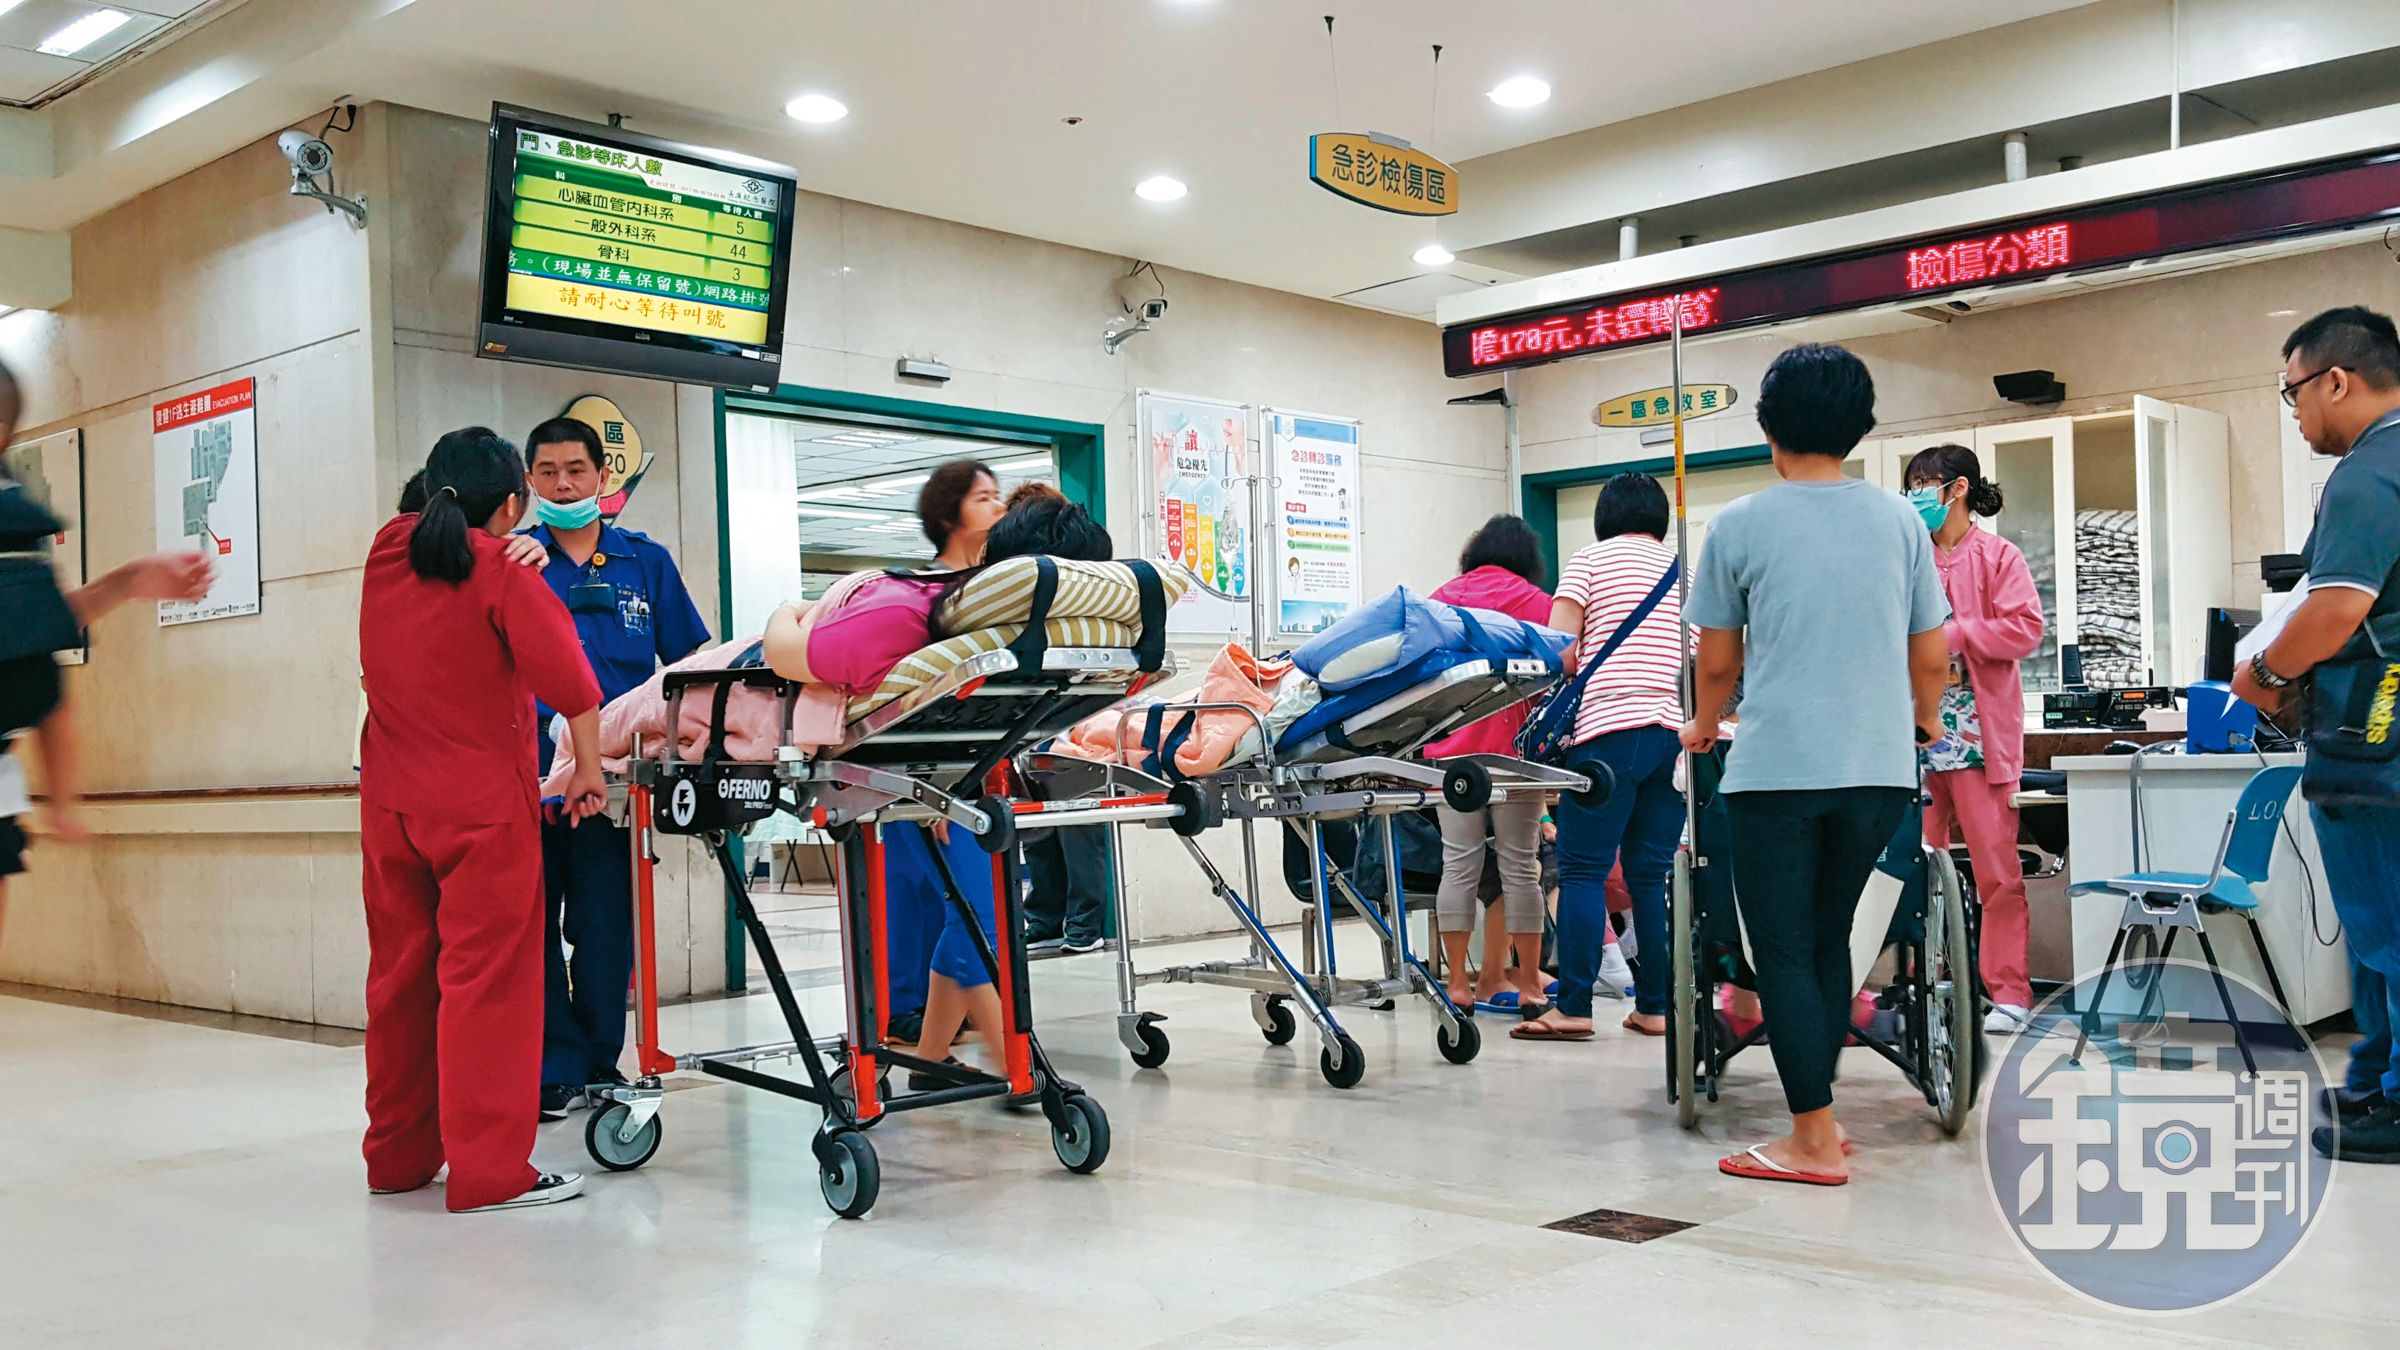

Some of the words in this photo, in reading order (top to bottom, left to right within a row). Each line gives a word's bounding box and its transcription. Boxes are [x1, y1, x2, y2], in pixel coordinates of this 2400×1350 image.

[520, 132, 663, 177] 門、急診等床人數
[1332, 143, 1446, 205] 急診檢傷區
[558, 187, 674, 222] 心臟血管內科系
[736, 221, 744, 235] 5
[722, 203, 763, 220] 等待人數
[574, 218, 657, 242] 一般外科系
[730, 244, 747, 259] 44
[1906, 224, 2069, 289] 檢傷分類
[598, 244, 630, 262] 骨科
[732, 267, 741, 281] 3
[559, 286, 726, 329] 請耐心等待叫號
[212, 394, 239, 409] EVACUATION
[729, 778, 772, 801] FERNO
